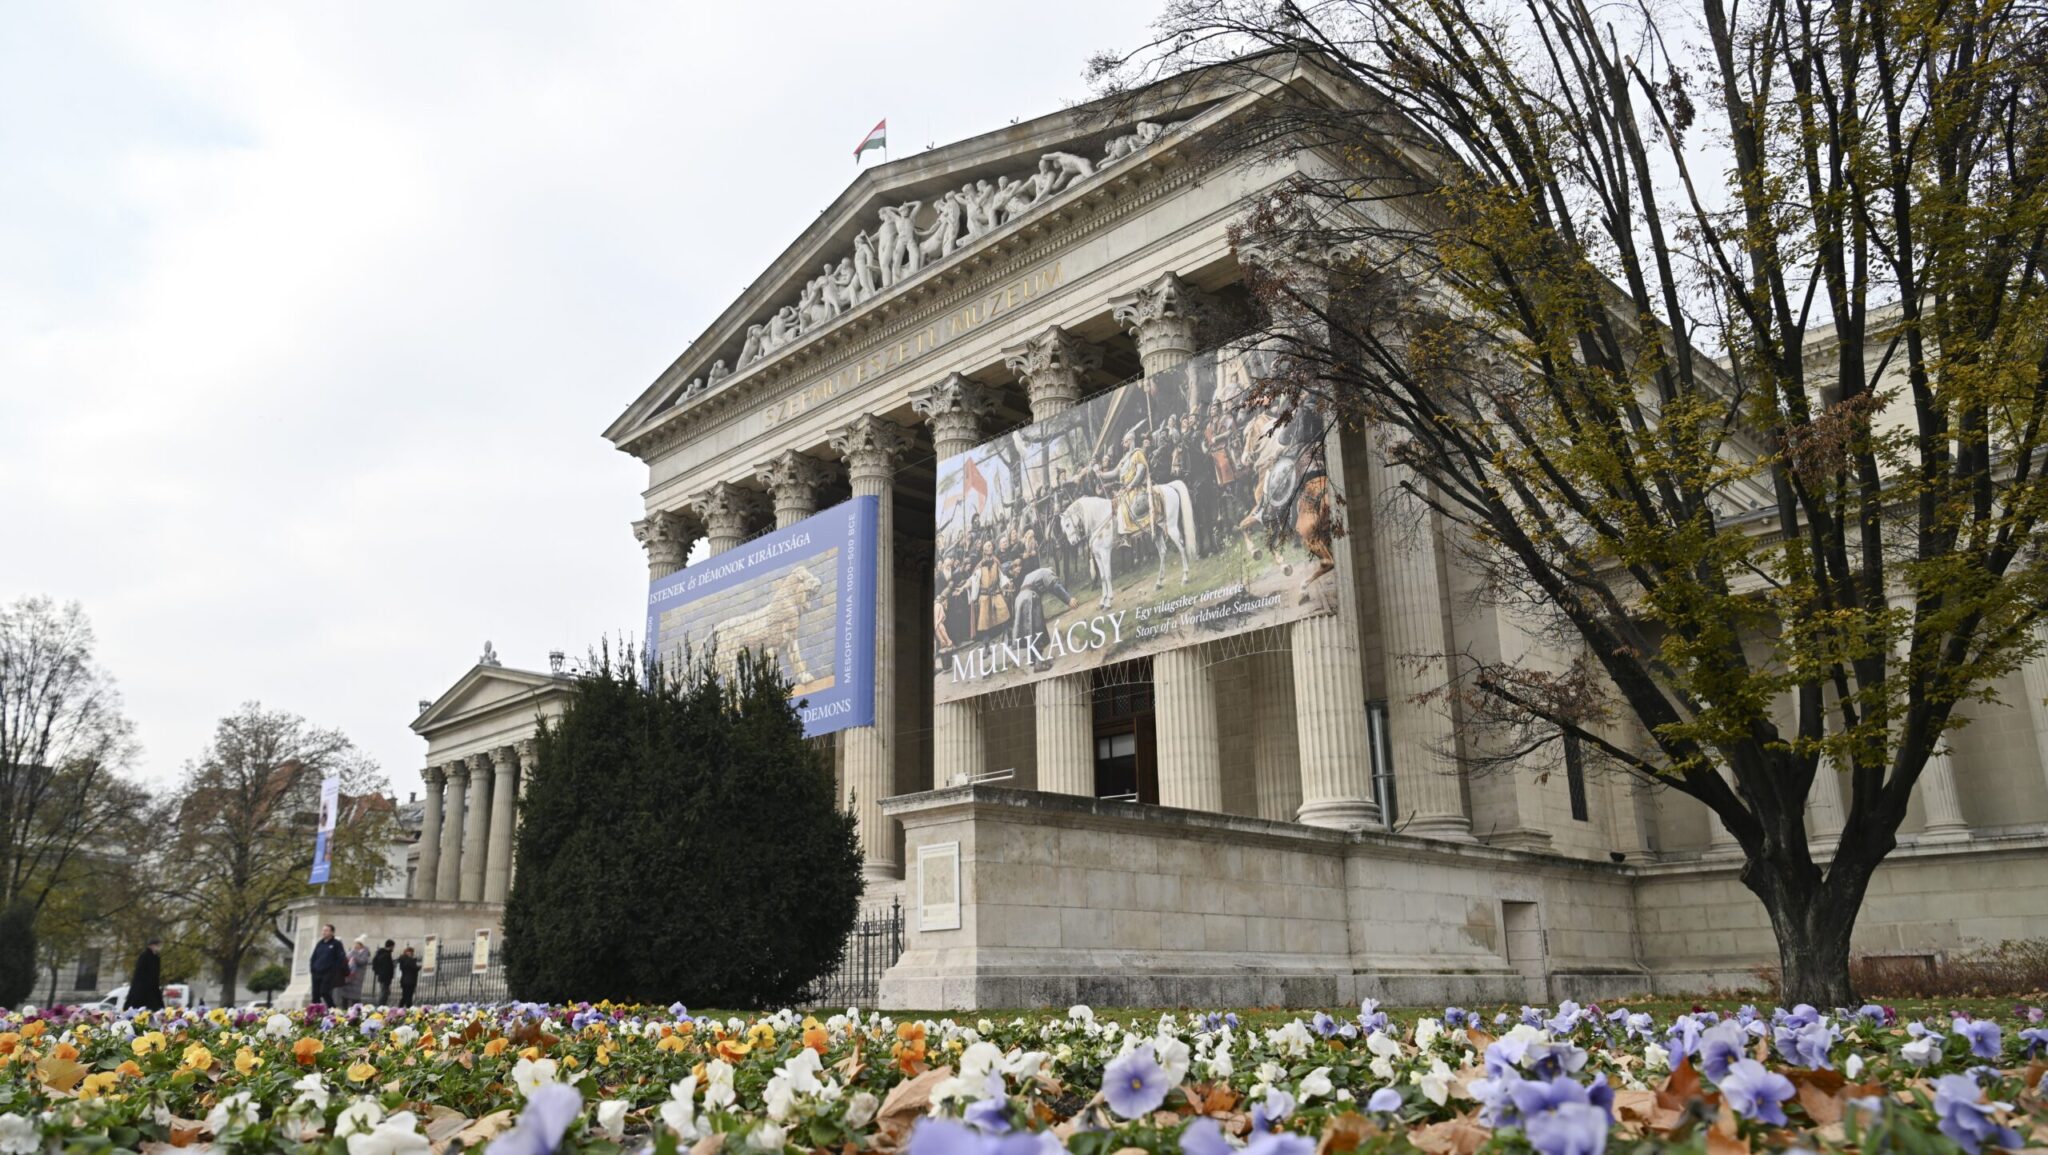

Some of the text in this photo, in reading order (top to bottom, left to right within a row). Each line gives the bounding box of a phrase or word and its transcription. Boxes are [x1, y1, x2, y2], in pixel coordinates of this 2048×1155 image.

[848, 511, 856, 536] BCE
[649, 581, 686, 604] ISTENEK
[698, 558, 745, 586] DÉMONOK
[748, 532, 811, 567] KIRÁLYSÁGA
[1135, 582, 1244, 621] Egy világsiker története
[1135, 593, 1282, 639] Story of a Worldwide Sensation
[844, 594, 853, 684] MESOPOTAMIA
[951, 609, 1127, 683] MUNKÁCSY
[803, 698, 852, 724] DEMONS
